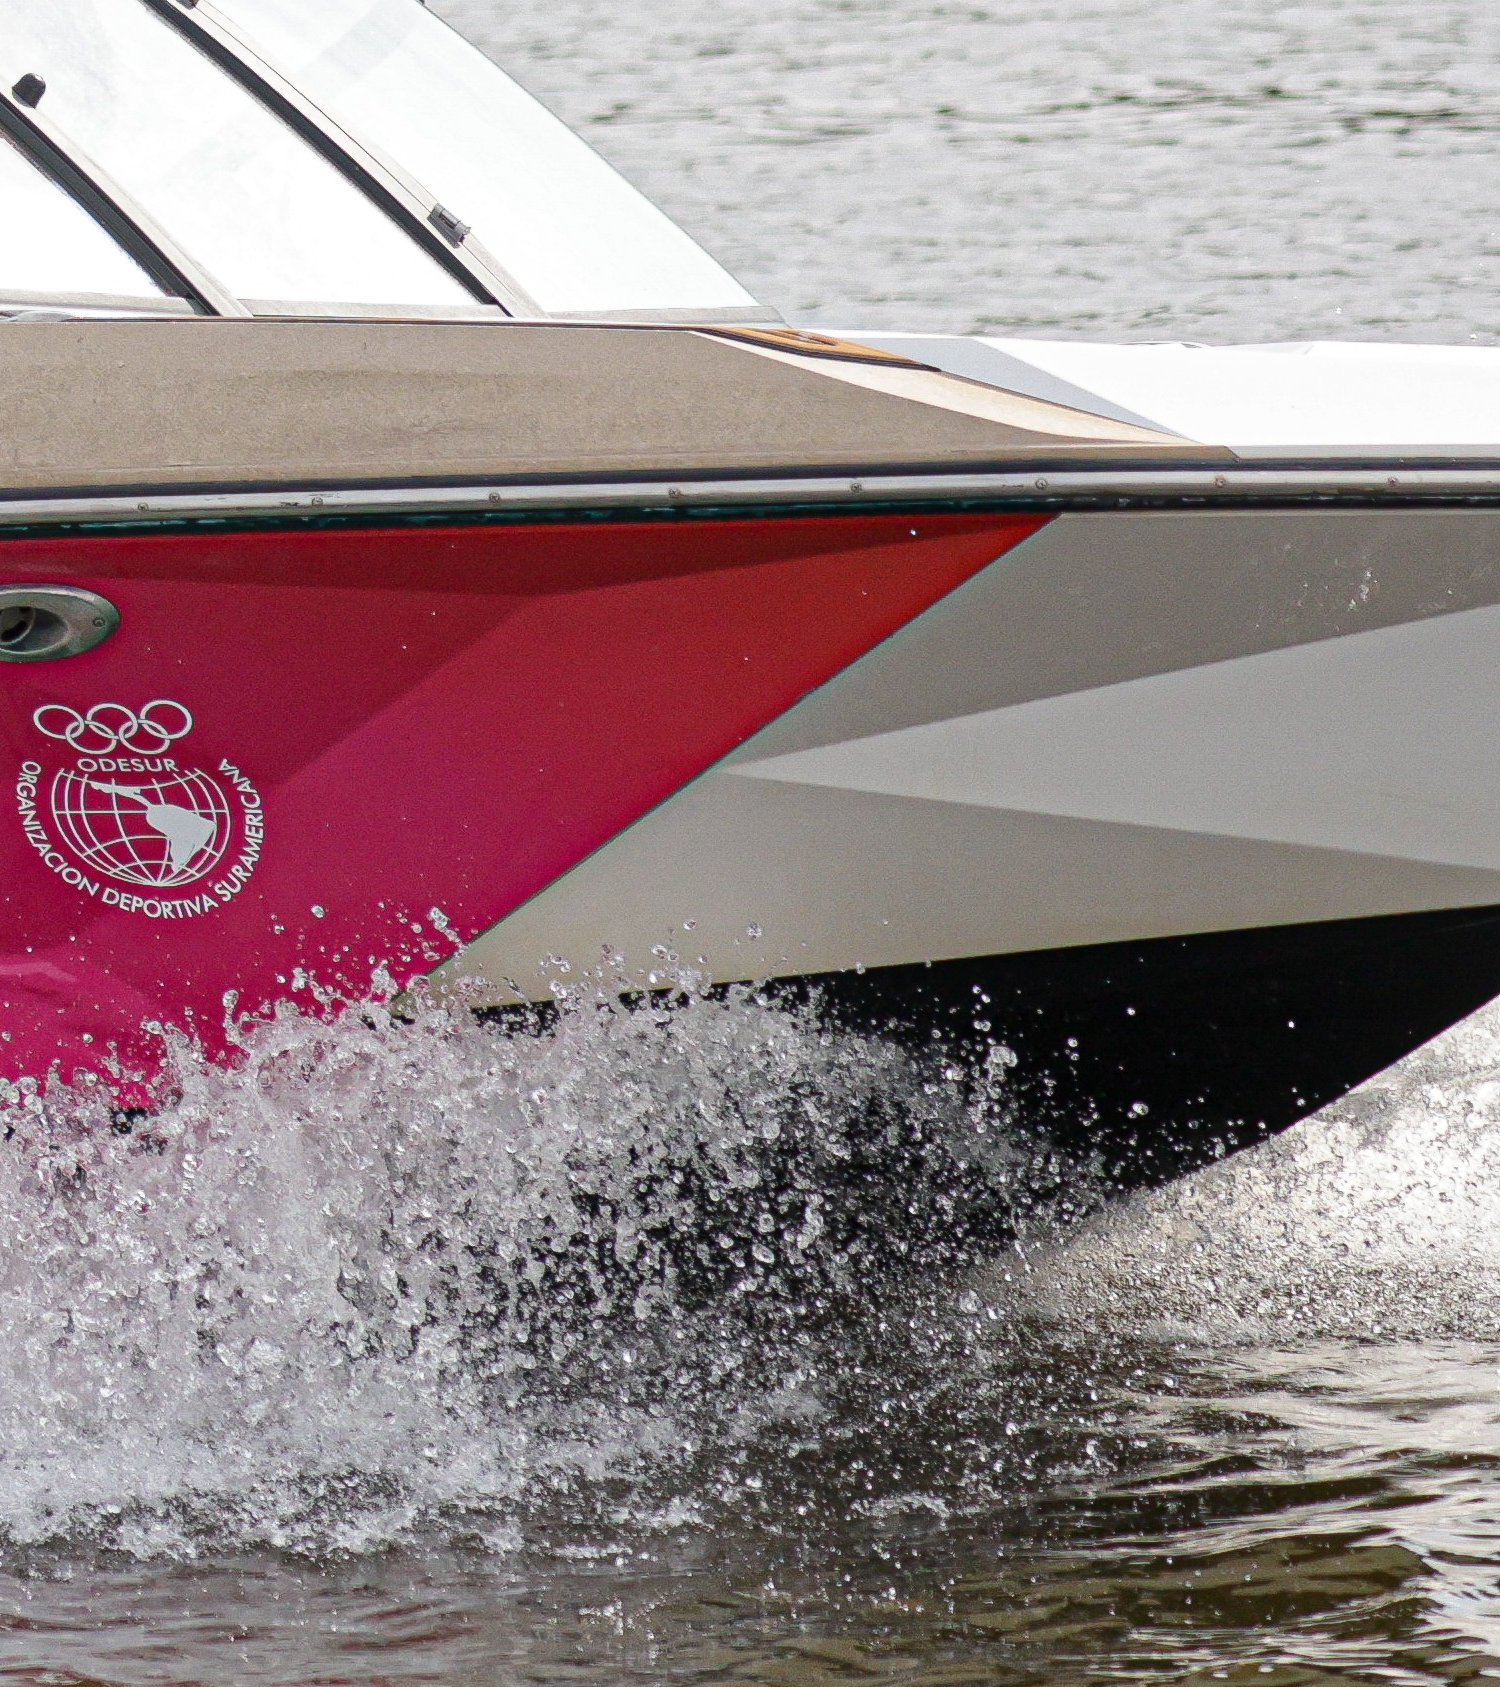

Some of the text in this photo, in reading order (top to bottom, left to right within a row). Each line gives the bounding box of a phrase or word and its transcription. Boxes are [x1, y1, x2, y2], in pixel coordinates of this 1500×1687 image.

[76, 757, 180, 773] ODESUR
[15, 758, 265, 919] ORGANIZACION DEPORTIVA SURAMERICANA
